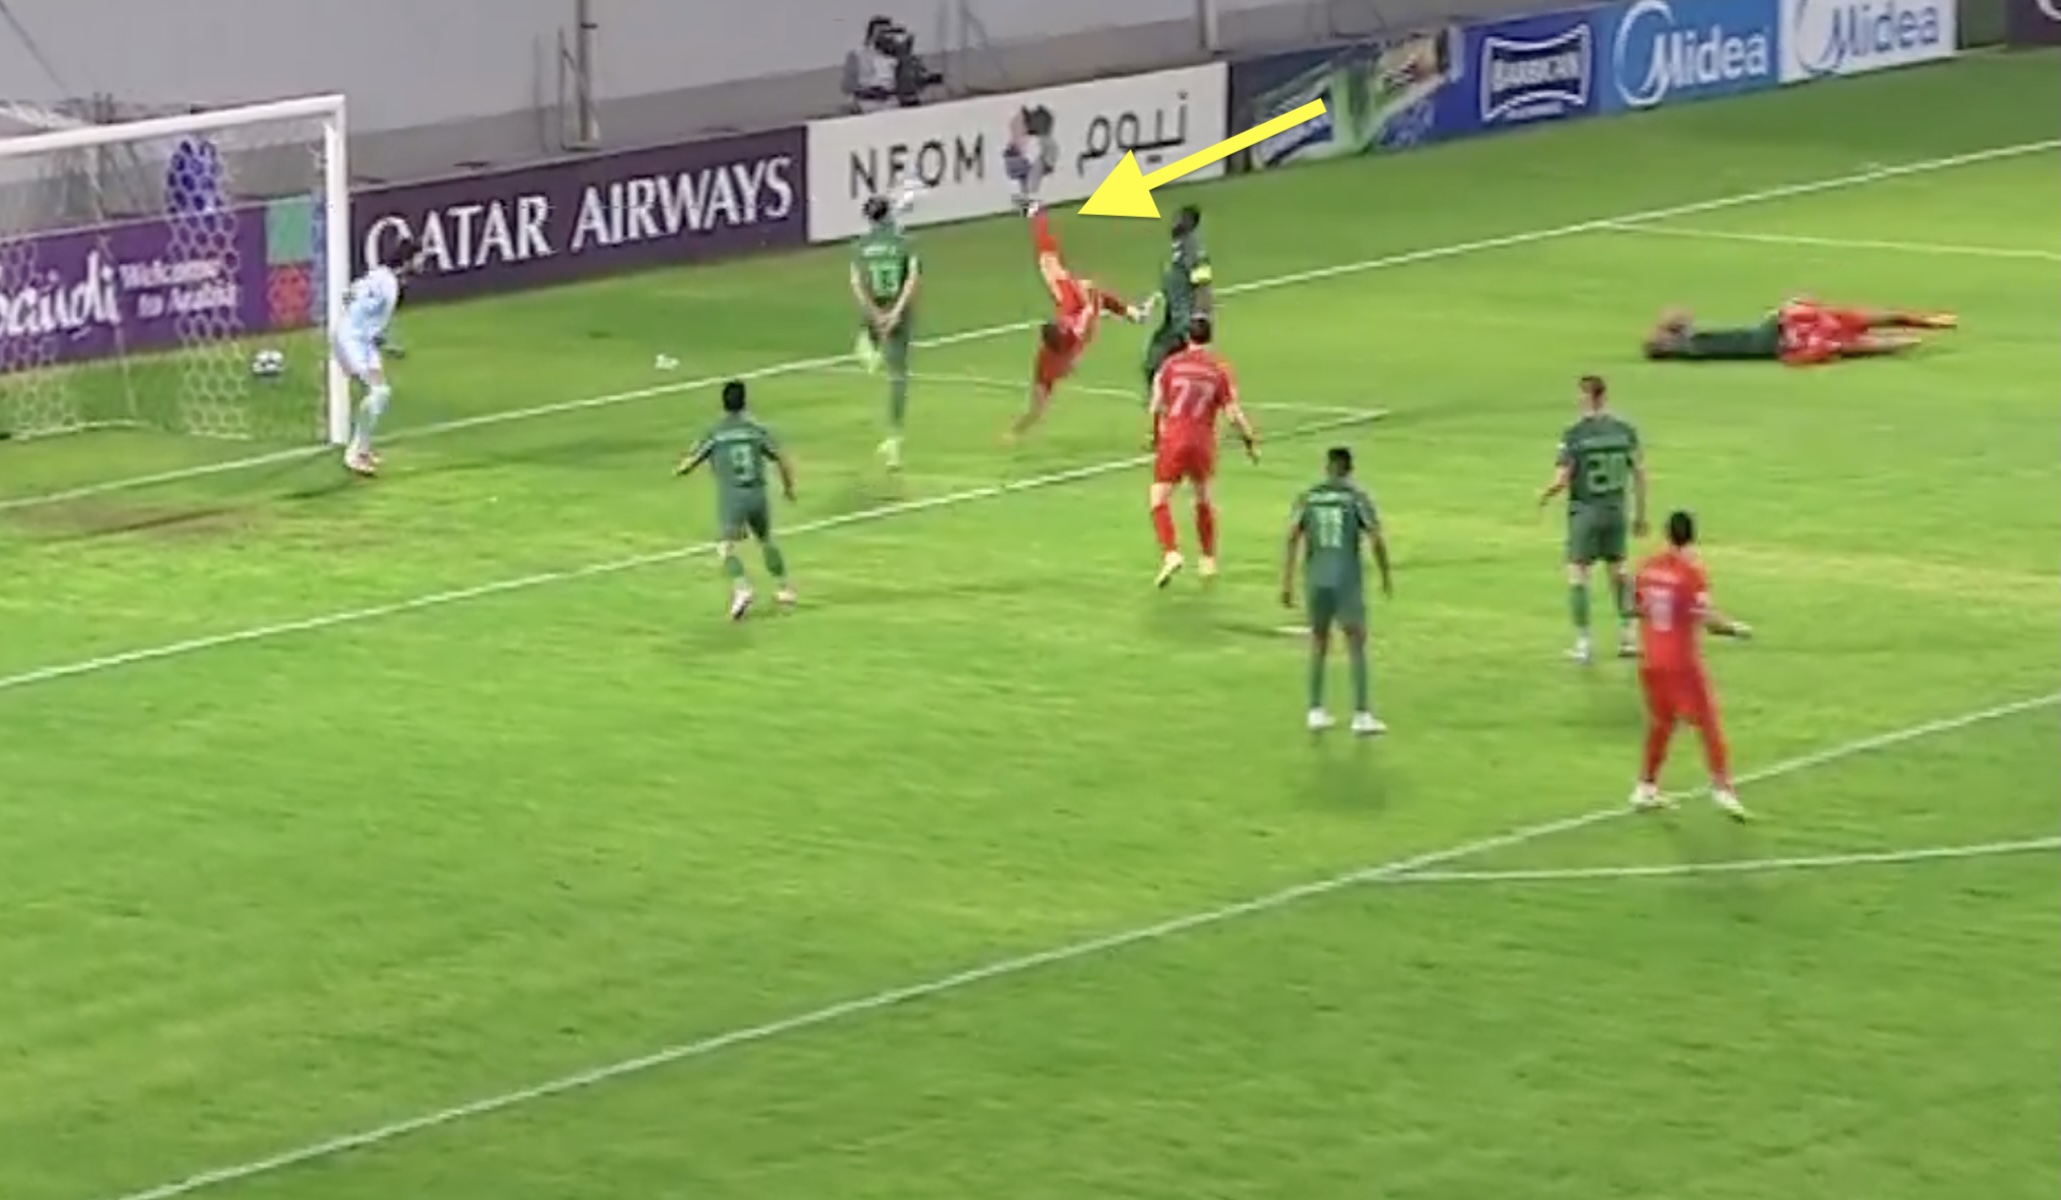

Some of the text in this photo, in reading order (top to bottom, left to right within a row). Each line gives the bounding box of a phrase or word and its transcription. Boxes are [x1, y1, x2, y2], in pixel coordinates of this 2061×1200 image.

[1637, 22, 1769, 94] Midea
[571, 156, 793, 253] AIRWAYS
[1170, 377, 1217, 418] 77
